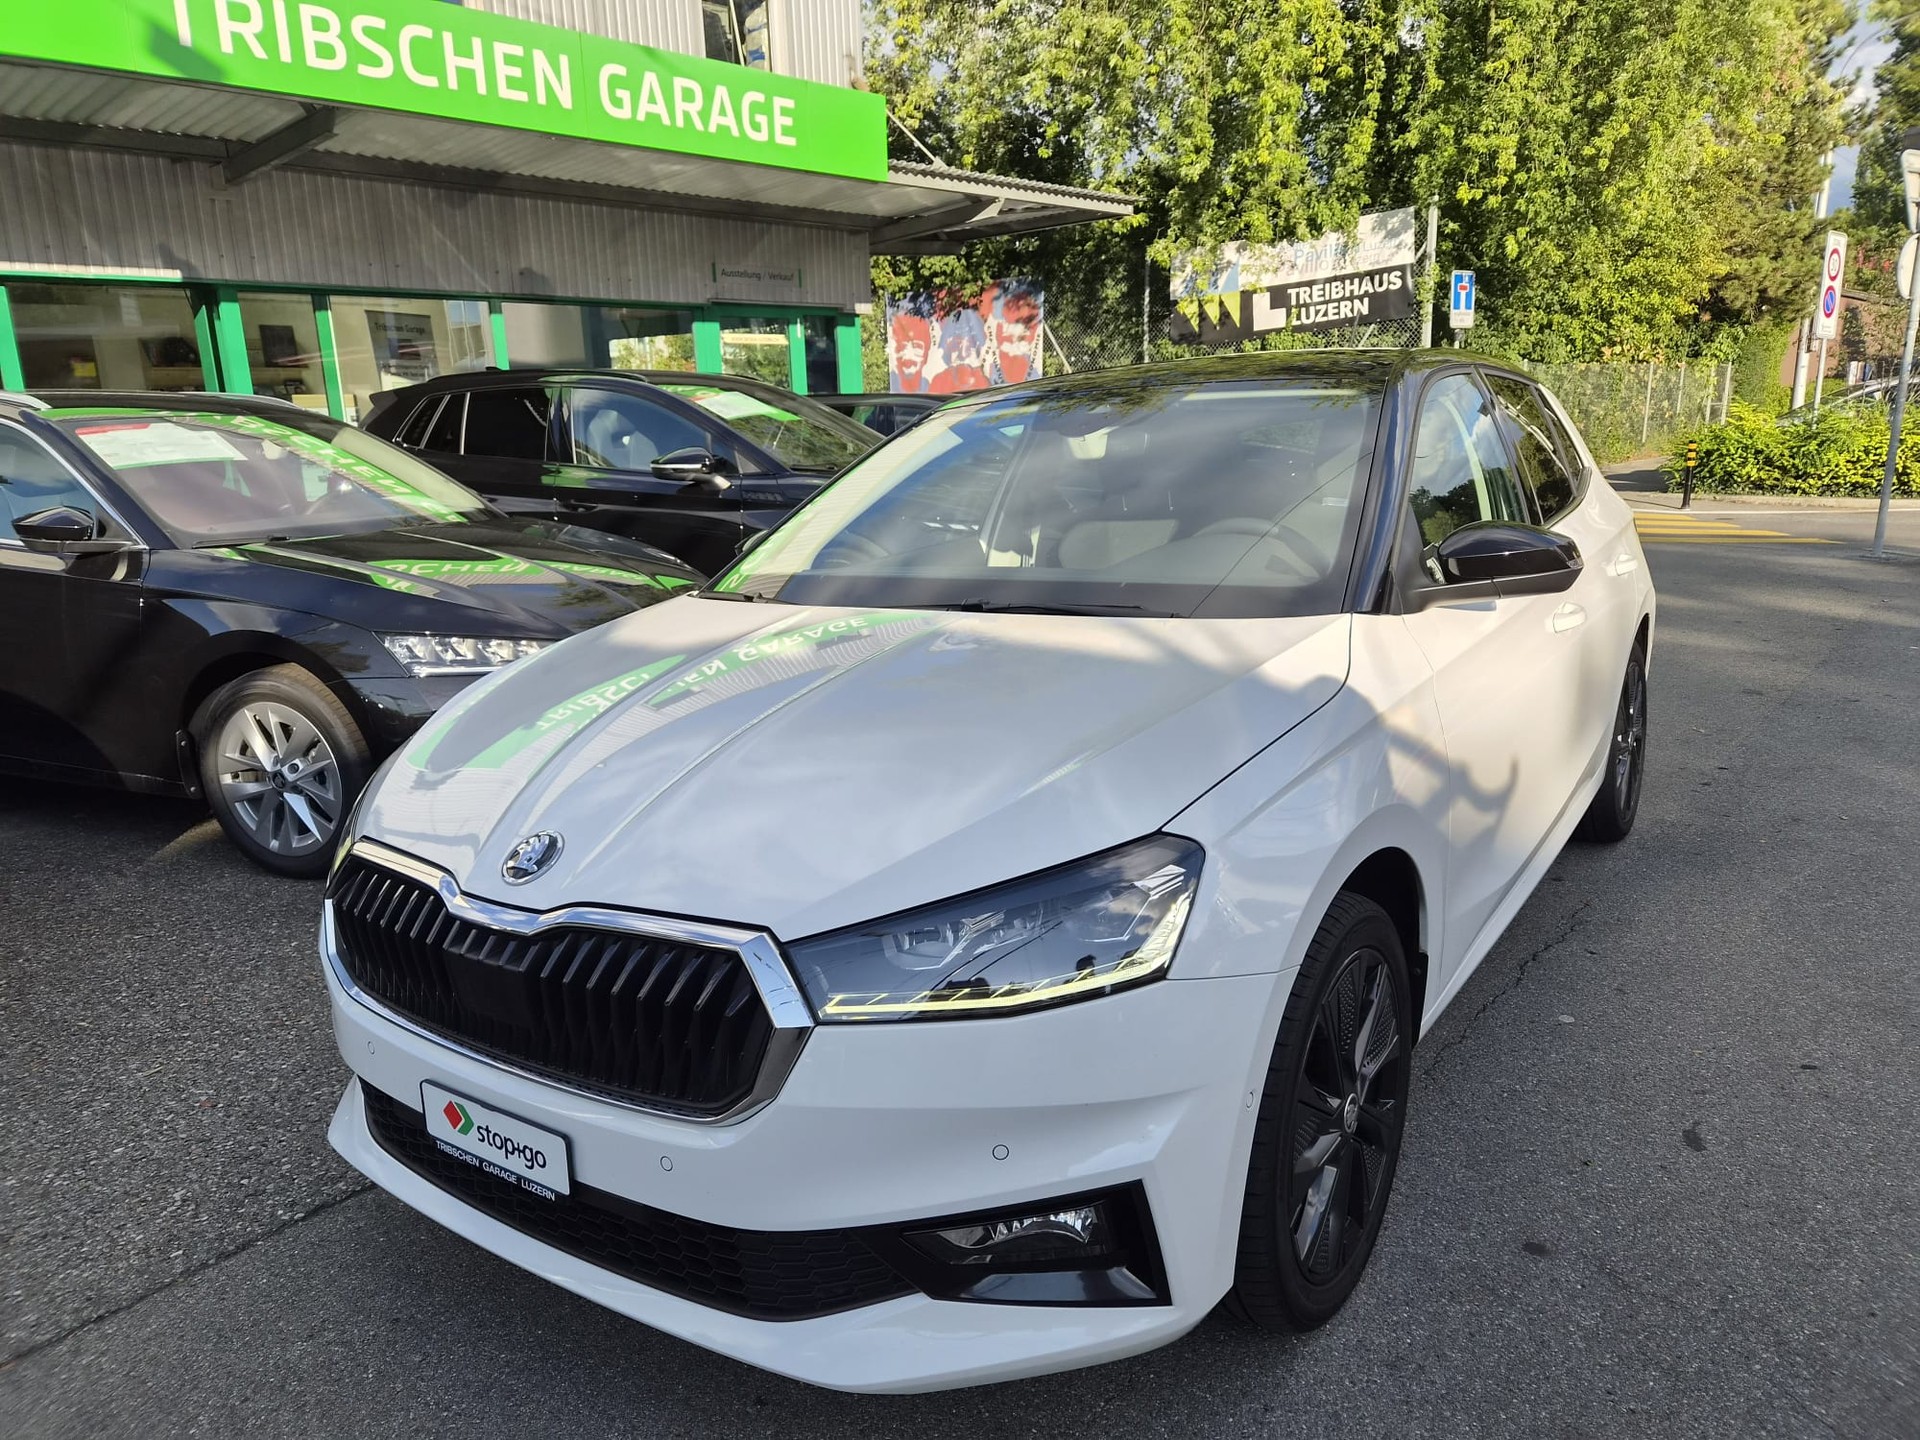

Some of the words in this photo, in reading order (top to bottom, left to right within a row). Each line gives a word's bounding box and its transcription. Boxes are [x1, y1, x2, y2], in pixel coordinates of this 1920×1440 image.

[598, 62, 797, 147] GARAGE
[720, 268, 761, 281] Ausstellung
[768, 271, 794, 282] Verkauf
[1287, 271, 1403, 306] TREIBHAUS
[1291, 297, 1369, 326] LUZERN
[476, 1125, 547, 1170] stop+go
[435, 1140, 480, 1168] TRIBSCHEN
[482, 1161, 518, 1184] GARAGE
[521, 1178, 556, 1202] LUZERN
